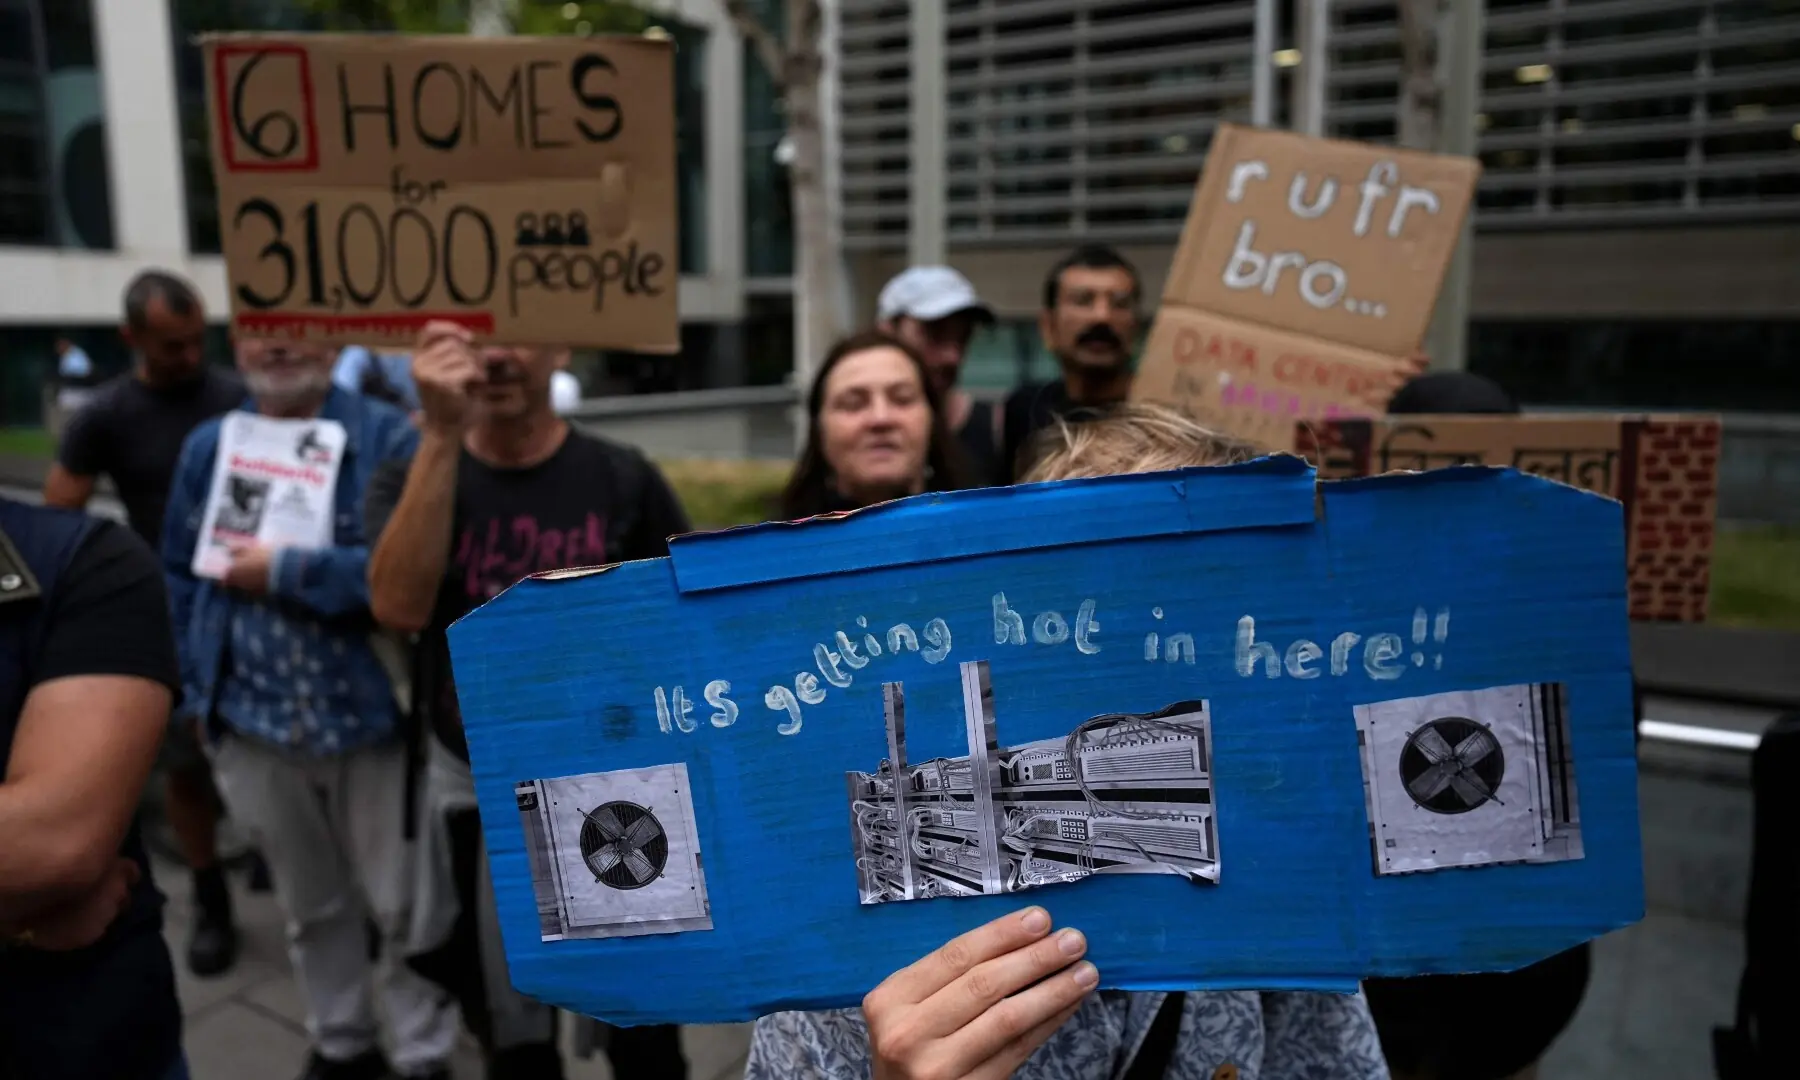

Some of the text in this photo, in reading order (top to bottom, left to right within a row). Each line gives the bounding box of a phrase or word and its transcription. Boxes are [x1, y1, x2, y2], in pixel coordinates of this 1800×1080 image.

[232, 50, 624, 158] 6 HOMES
[391, 164, 447, 202] for
[1226, 160, 1269, 203] r
[234, 198, 665, 318] 31,000 people
[1222, 219, 1389, 319] bro...
[1173, 327, 1258, 372] DATA
[764, 615, 952, 735] getting
[992, 591, 1102, 656] hot
[1144, 606, 1197, 666] in
[1234, 606, 1450, 681] here!!
